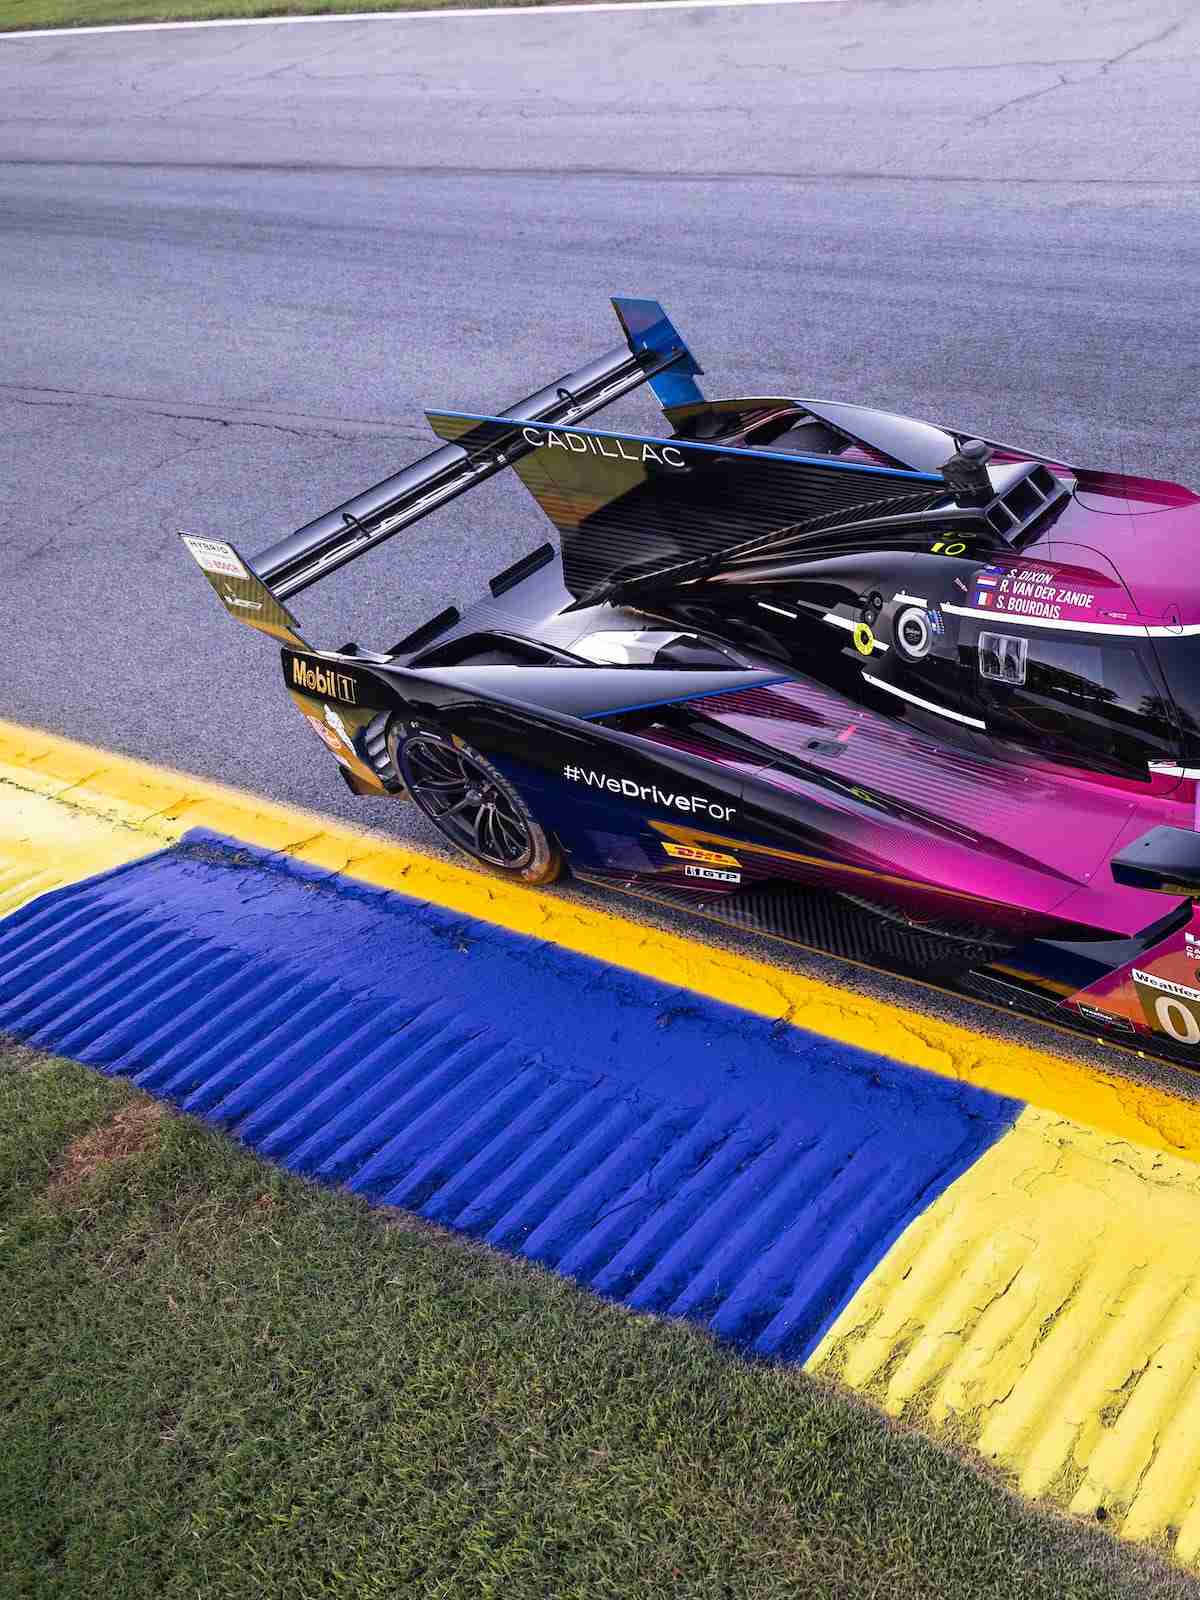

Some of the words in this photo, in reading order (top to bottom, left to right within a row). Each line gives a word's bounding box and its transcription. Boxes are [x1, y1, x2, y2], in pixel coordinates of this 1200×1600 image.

[522, 427, 685, 467] CADILLAC
[1007, 568, 1017, 579] S.
[1019, 570, 1053, 585] DIXON
[996, 596, 1007, 609] S.
[1008, 597, 1061, 619] BOURDAIS
[999, 580, 1010, 592] R.
[1012, 582, 1032, 596] VAN
[1034, 586, 1056, 600] DER
[1056, 590, 1095, 608] ZANDE
[293, 658, 337, 698] Mobil
[563, 764, 737, 822] #WeDriveFor
[677, 847, 733, 863] DHL
